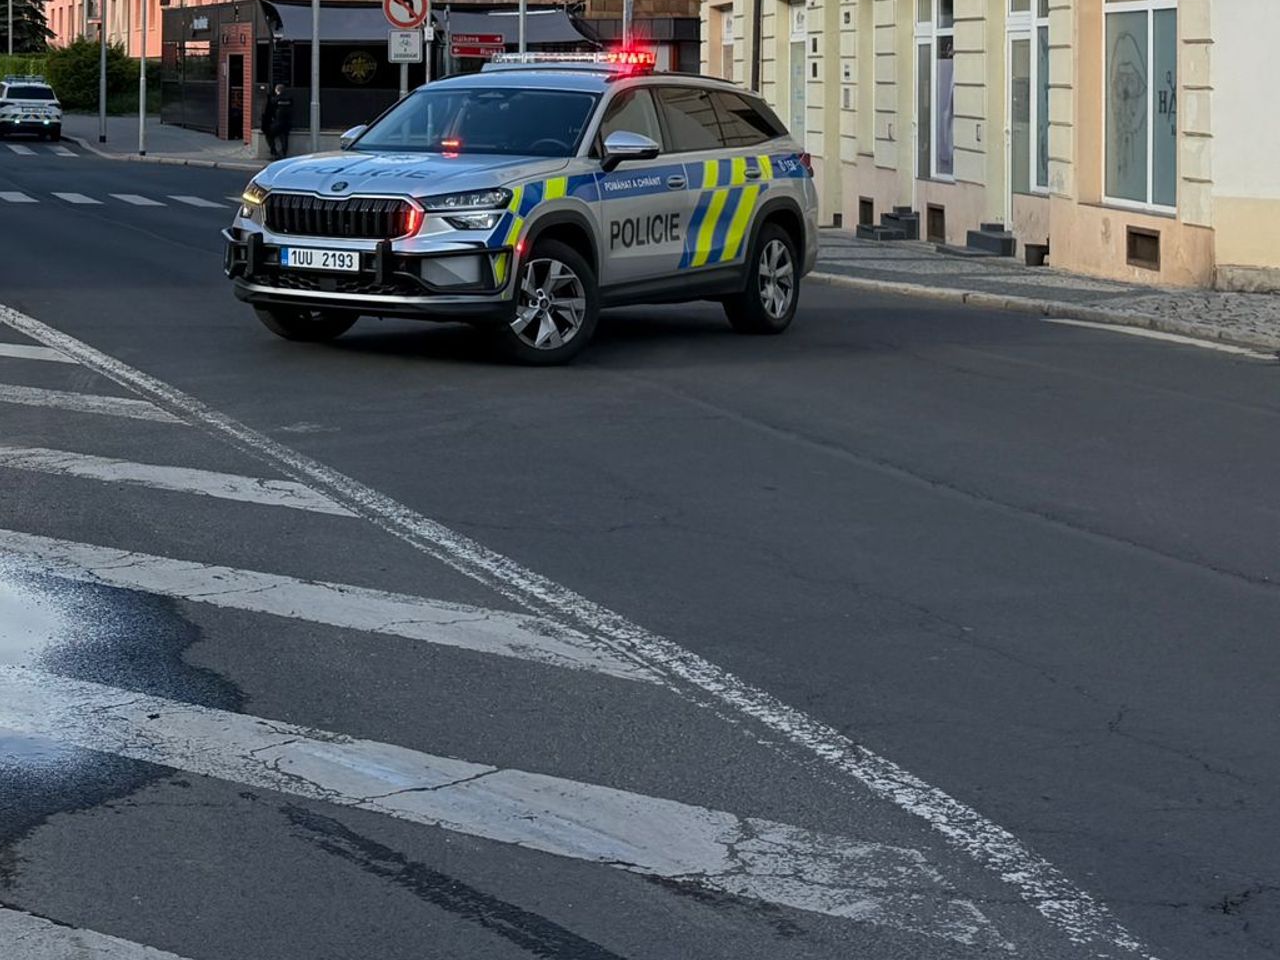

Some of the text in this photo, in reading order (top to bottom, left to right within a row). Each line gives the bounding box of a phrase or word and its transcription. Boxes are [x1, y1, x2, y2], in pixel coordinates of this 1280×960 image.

[291, 166, 436, 179] POLICIE
[610, 213, 680, 251] POLICIE
[291, 250, 354, 268] 1UU 2193
